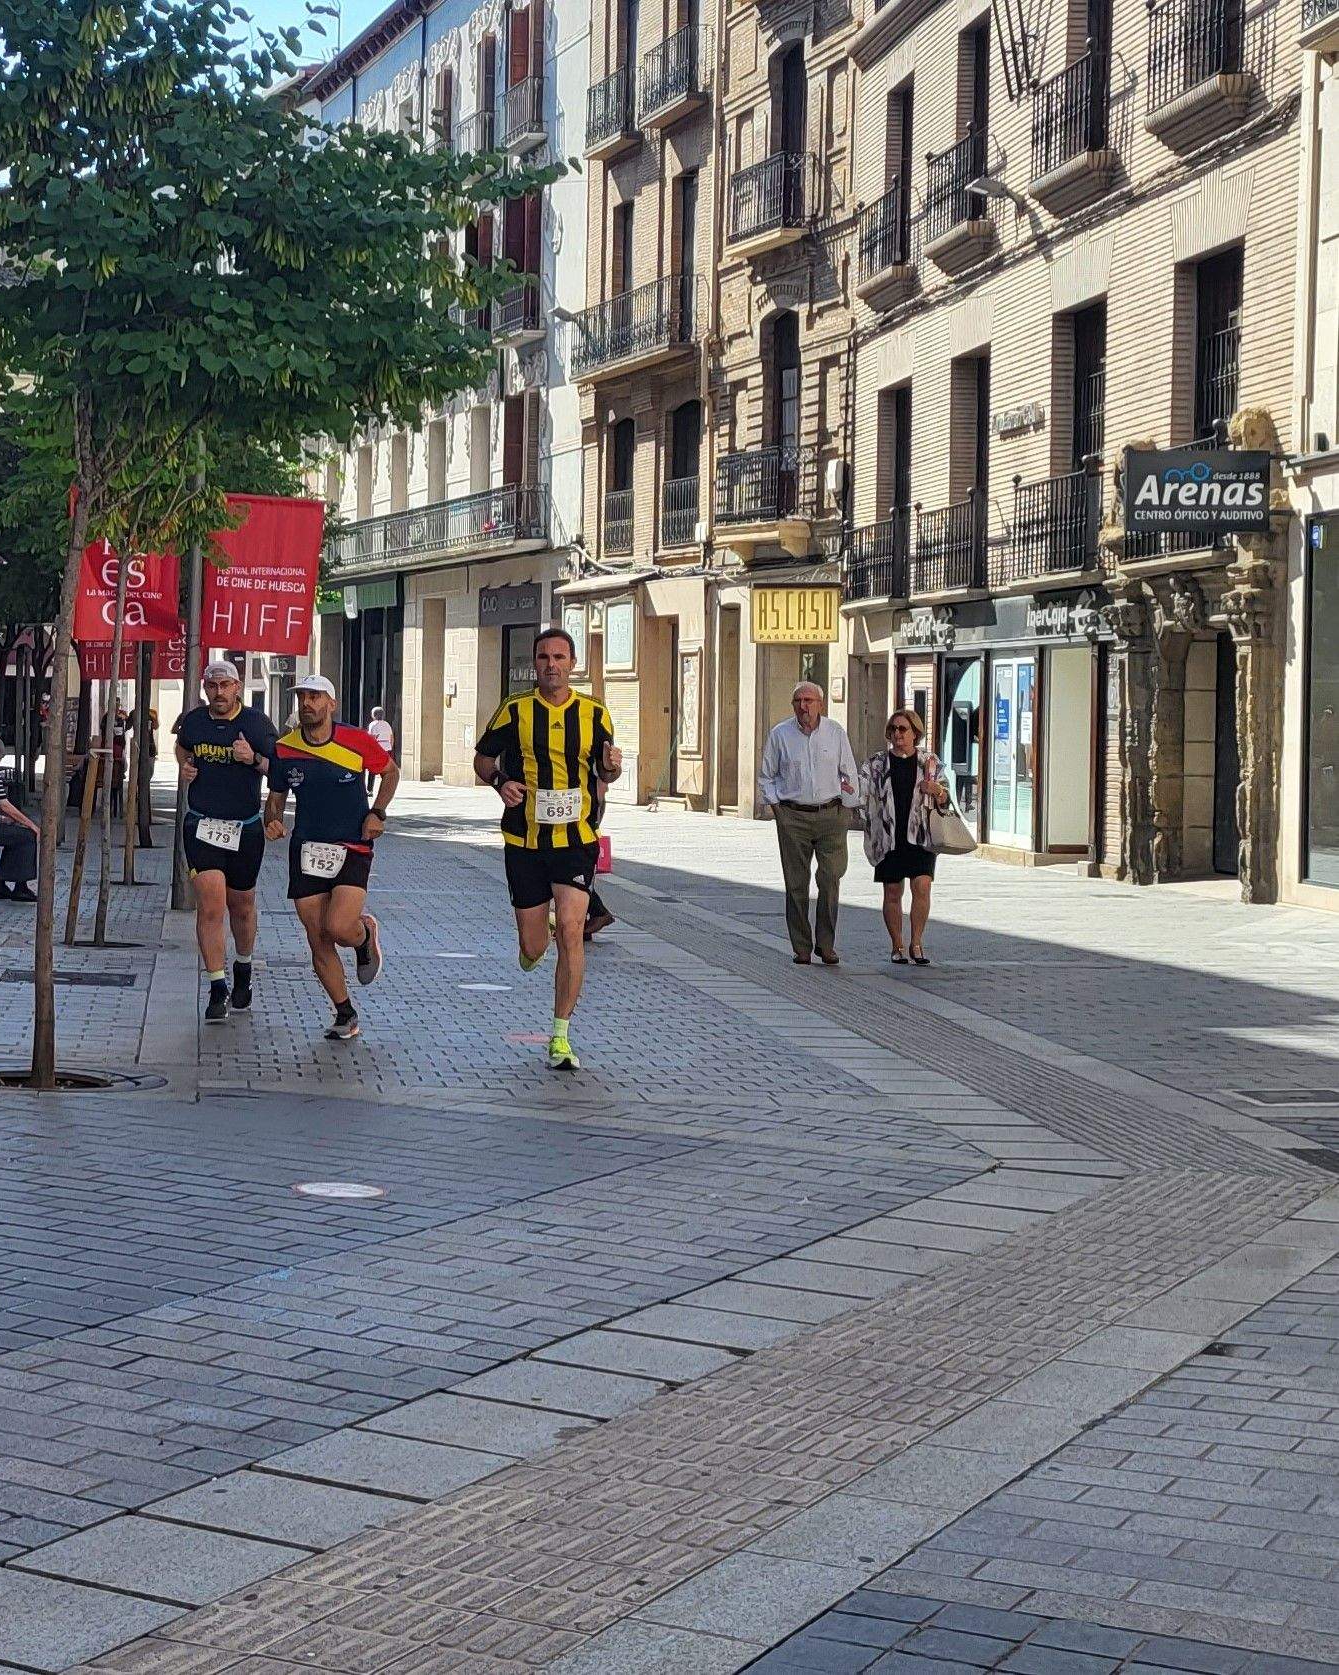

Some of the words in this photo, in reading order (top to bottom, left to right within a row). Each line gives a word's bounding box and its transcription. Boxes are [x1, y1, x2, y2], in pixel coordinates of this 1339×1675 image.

[1213, 472, 1238, 481] desde
[1134, 474, 1265, 506] Arenas
[1134, 510, 1172, 520] CENTRO
[1174, 508, 1210, 520] ÓPTICO
[1212, 510, 1218, 520] Y
[1219, 510, 1264, 520] AUDITIVO
[250, 566, 307, 576] INTERNACIONAL
[216, 576, 230, 587] DE
[231, 577, 253, 589] CINE
[254, 578, 267, 590] DE
[268, 581, 306, 593] HUESCA
[759, 591, 832, 630] ASCASO
[212, 600, 305, 639] HIFF
[194, 743, 235, 757] UBUNT
[546, 805, 573, 818] 693
[206, 830, 231, 843] 179
[309, 857, 335, 872] 152
